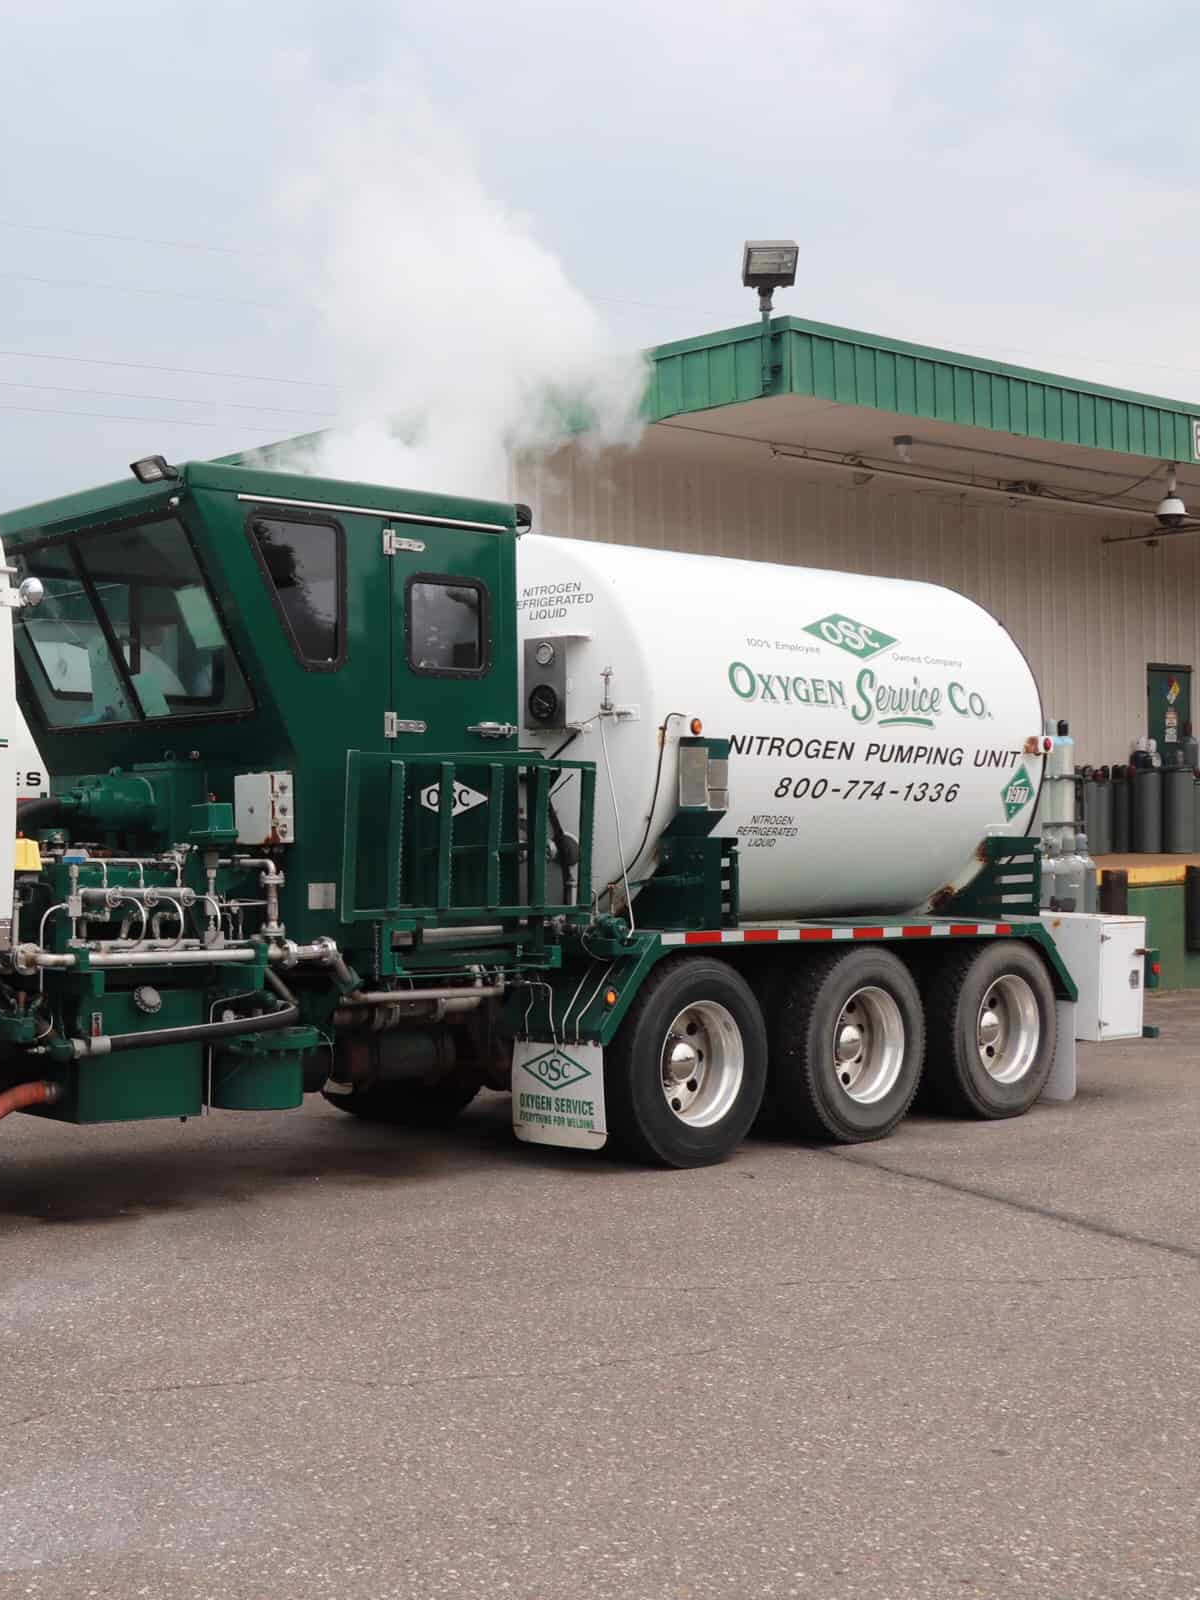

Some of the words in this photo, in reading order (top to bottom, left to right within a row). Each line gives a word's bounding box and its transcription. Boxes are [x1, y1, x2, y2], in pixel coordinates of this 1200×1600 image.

[522, 581, 582, 597] NITROGEN
[515, 593, 594, 611] EFRIGERATED
[528, 607, 567, 621] LIQUID
[746, 637, 772, 649] 100%
[820, 620, 881, 650] OSC
[851, 668, 941, 721] Service
[728, 734, 855, 761] NITROGEN
[865, 742, 964, 767] PUMPING
[973, 749, 1021, 769] UNIT
[426, 788, 471, 807] OC
[773, 776, 961, 803] 800-774-1336
[1007, 787, 1028, 802] 1977
[751, 815, 794, 825] NITROGEN
[736, 826, 799, 837] REFRIGERATED
[747, 838, 777, 848] LIQUID
[538, 1058, 570, 1081] OSC
[520, 1092, 552, 1112] OXYGEN
[554, 1097, 595, 1116] SERVICE
[519, 1110, 553, 1125] EVERYTHING
[553, 1115, 566, 1126] FOR
[567, 1116, 594, 1130] WELDING
